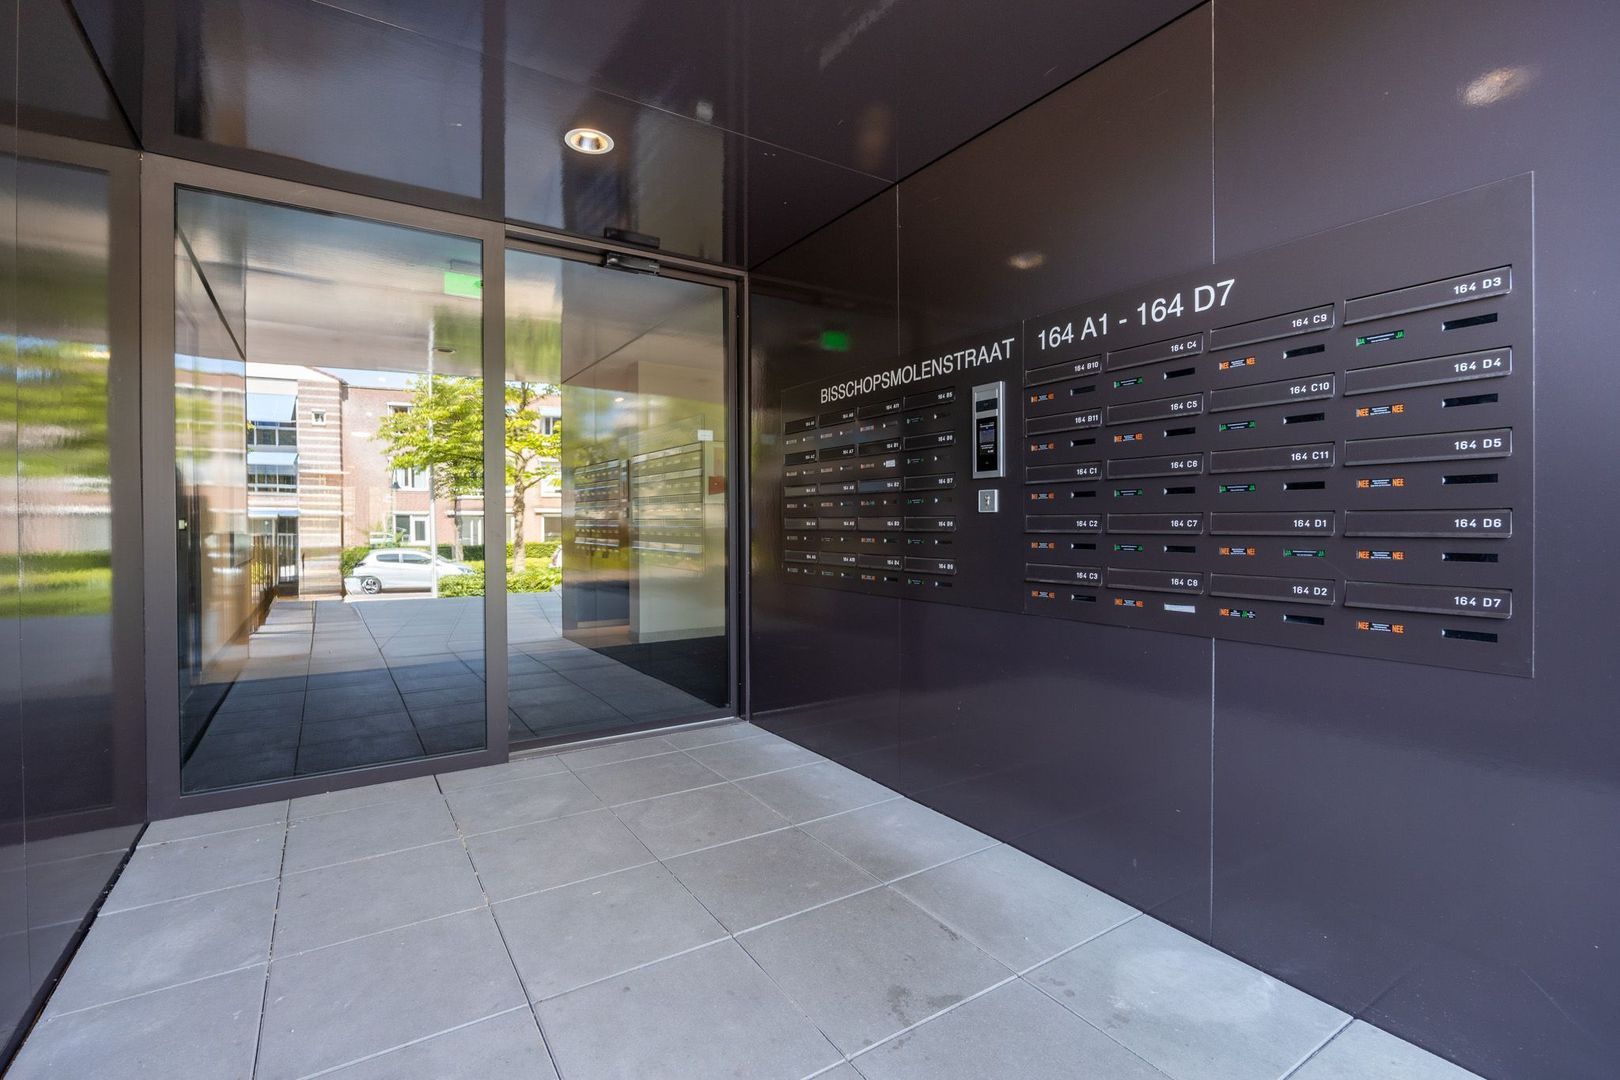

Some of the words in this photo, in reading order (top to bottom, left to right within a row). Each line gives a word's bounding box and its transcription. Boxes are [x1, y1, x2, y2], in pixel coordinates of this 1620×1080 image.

[1454, 282, 1476, 294] 164
[1482, 277, 1502, 290] D3
[1038, 322, 1074, 350] 164
[1081, 313, 1108, 341] A1
[1137, 293, 1184, 326] 164
[1194, 278, 1235, 312] D7
[1292, 317, 1308, 328] 164
[1313, 314, 1327, 324] C9
[1170, 343, 1184, 352] 164
[1187, 340, 1197, 349] C4
[1086, 361, 1099, 370] B10
[1454, 361, 1476, 372] 164
[1482, 358, 1501, 369] D4
[820, 338, 1015, 404] BISSCHOPSMOLENSTRAAT
[1290, 385, 1306, 394] 164
[1311, 382, 1330, 392] C10
[1170, 402, 1184, 411] 164
[1186, 400, 1198, 409] C5
[1358, 408, 1369, 416] NEE
[1392, 405, 1404, 413] NEE
[1454, 440, 1476, 450] 164
[1483, 438, 1502, 448] D5
[1291, 452, 1308, 461] 164
[1312, 451, 1329, 460] C11
[1186, 460, 1198, 468] C6
[1358, 480, 1369, 488] NEE
[1186, 520, 1198, 528] C7
[1294, 519, 1310, 528] 164
[1314, 519, 1326, 528] D1
[1454, 518, 1476, 528] 164
[1483, 518, 1502, 528] D6
[1187, 578, 1198, 587] C8
[1292, 586, 1309, 594] 164
[1314, 587, 1328, 596] D2
[1454, 596, 1476, 606] 164
[1483, 598, 1501, 608] D7
[1392, 625, 1404, 633] NEE
